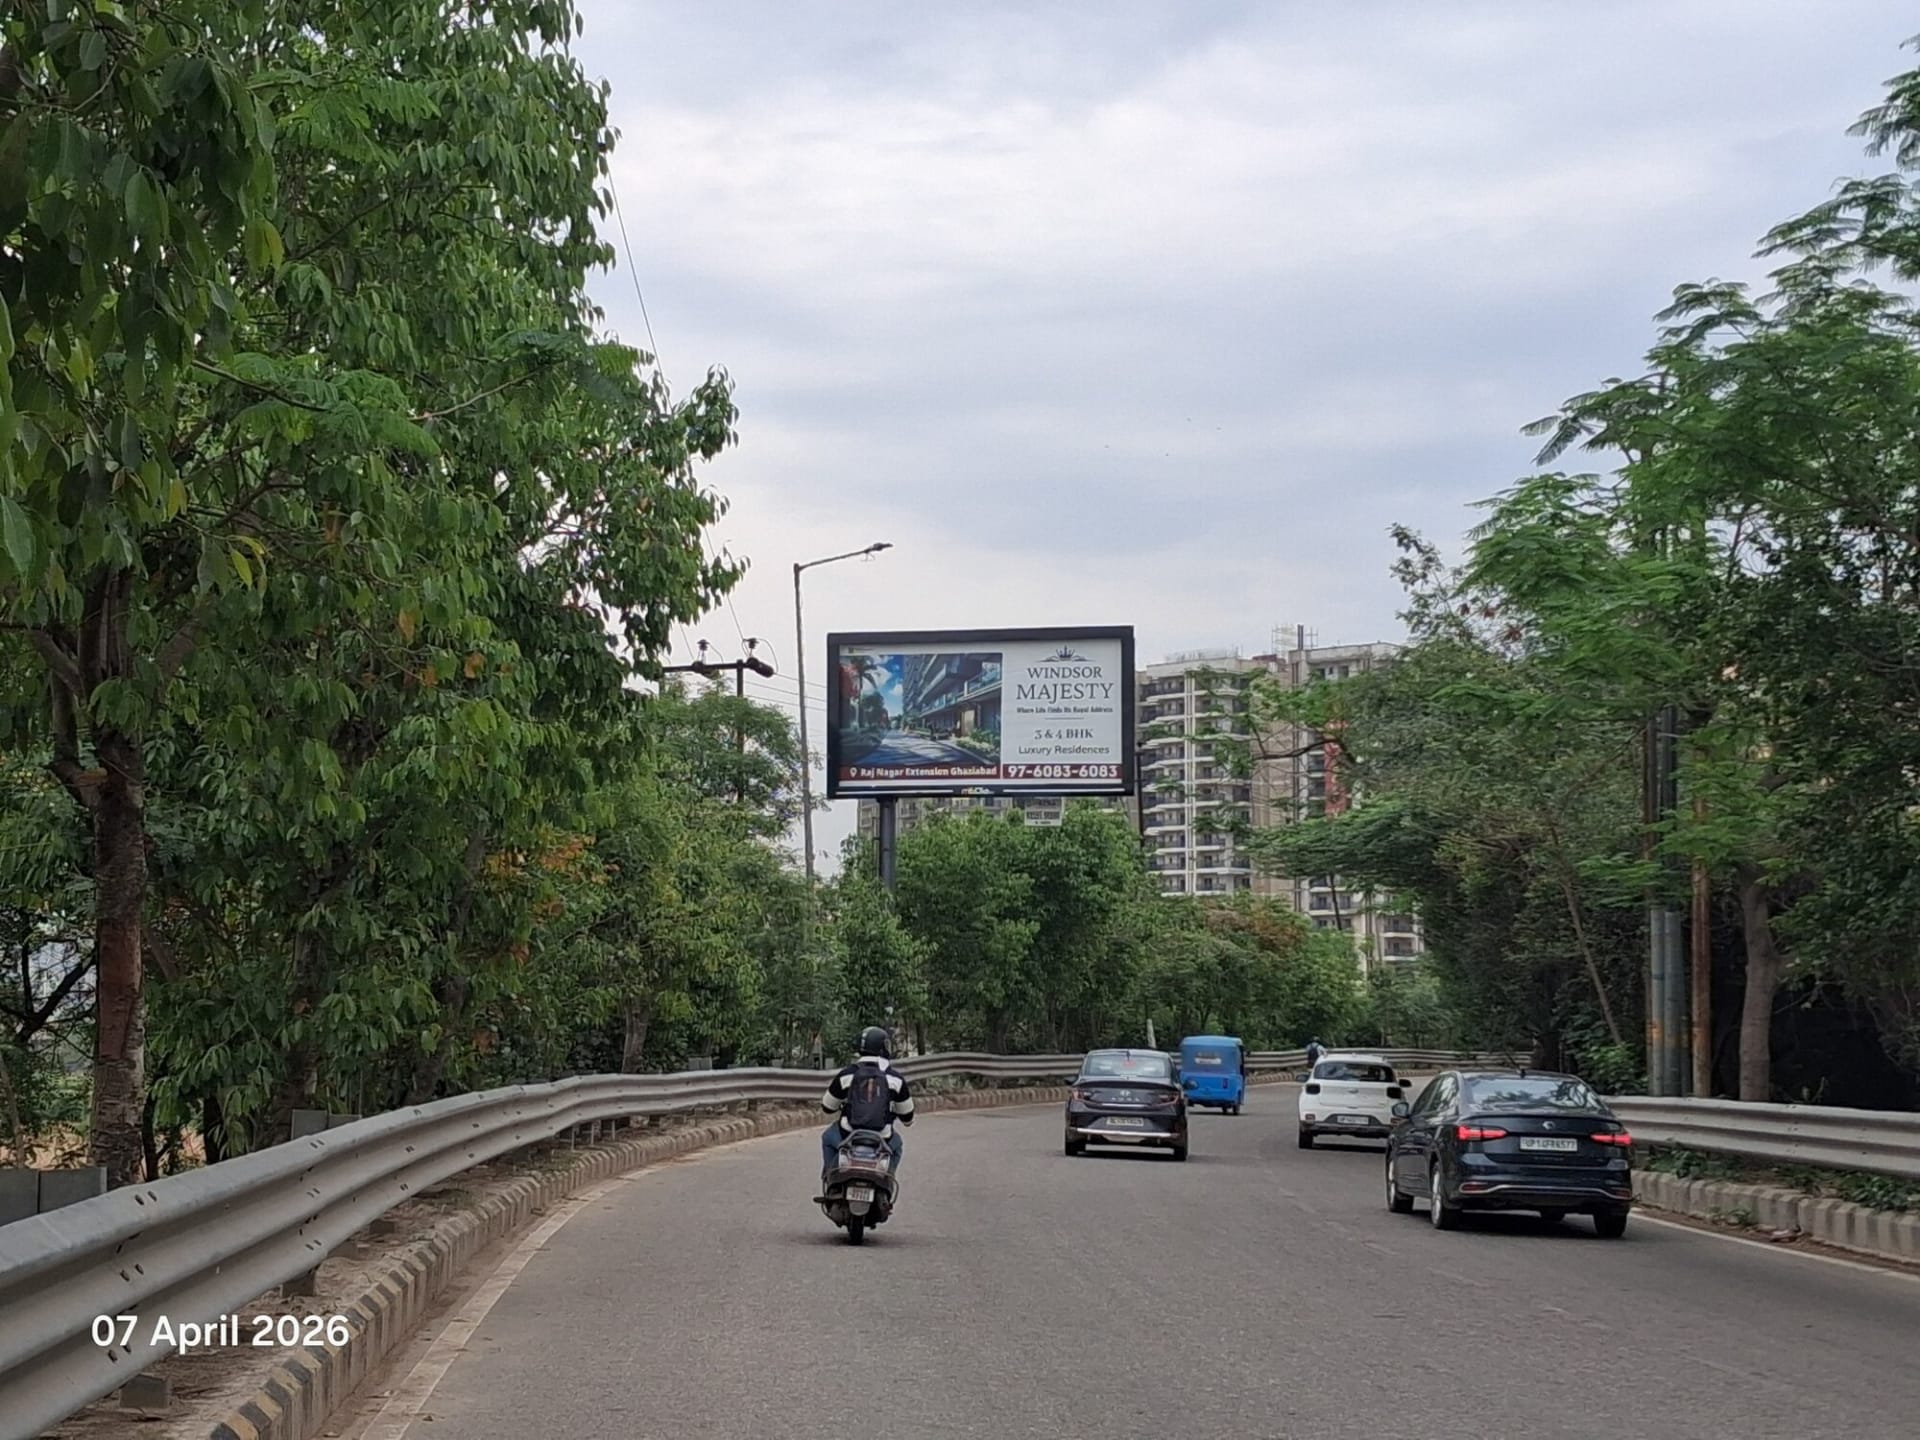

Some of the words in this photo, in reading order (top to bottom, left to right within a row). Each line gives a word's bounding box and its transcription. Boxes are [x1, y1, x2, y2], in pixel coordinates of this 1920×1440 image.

[1027, 666, 1102, 679] WINDSOR
[1016, 683, 1114, 704] MAJESTY
[1034, 730, 1042, 740] 3
[1044, 729, 1054, 739] &
[1056, 729, 1062, 740] 4
[1066, 728, 1094, 739] BHK
[1018, 745, 1051, 756] Luxury
[1054, 745, 1110, 754] Residences
[860, 767, 875, 778] Raj
[876, 767, 903, 778] Nagar
[905, 767, 949, 777] Extension
[950, 766, 997, 776] Ghaziabad
[1008, 765, 1118, 778] 97-6083-6083
